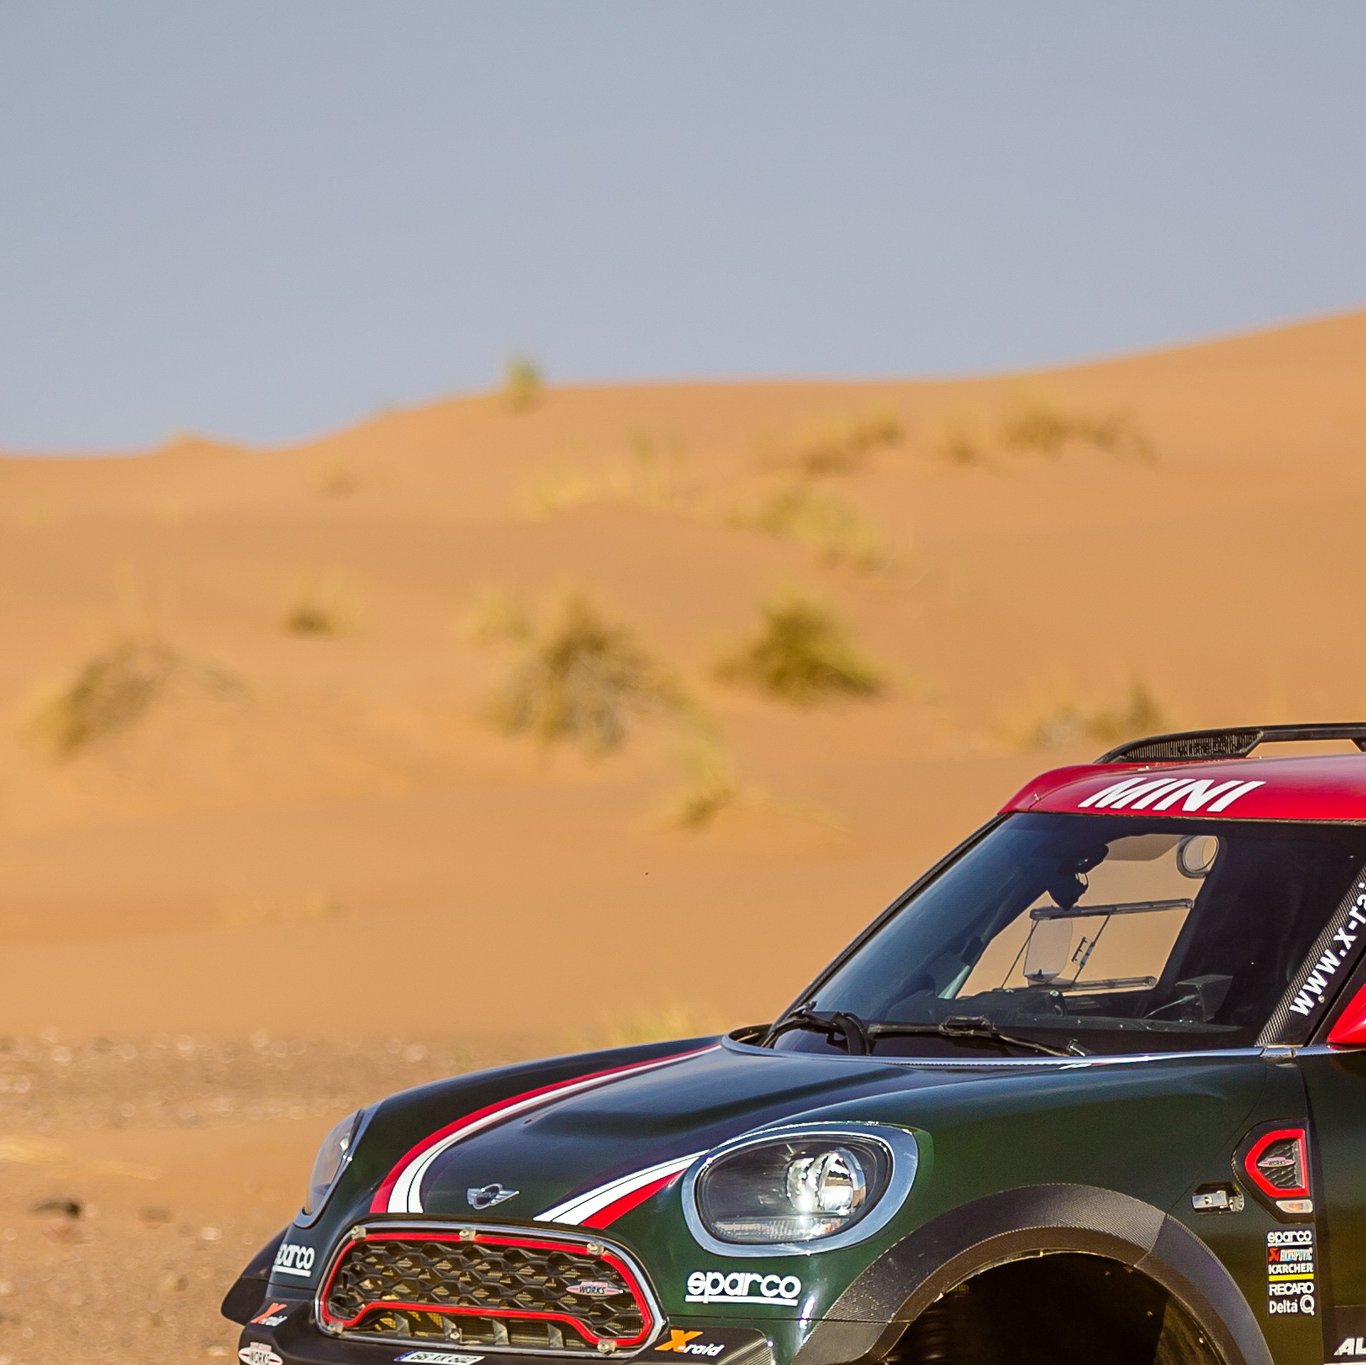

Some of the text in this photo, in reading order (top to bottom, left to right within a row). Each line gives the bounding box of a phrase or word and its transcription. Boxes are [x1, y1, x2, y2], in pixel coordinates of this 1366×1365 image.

[1077, 777, 1267, 812] MINI
[1267, 1230, 1312, 1246] sparco
[687, 1271, 802, 1304] sparco
[1269, 1281, 1315, 1296] RECARO
